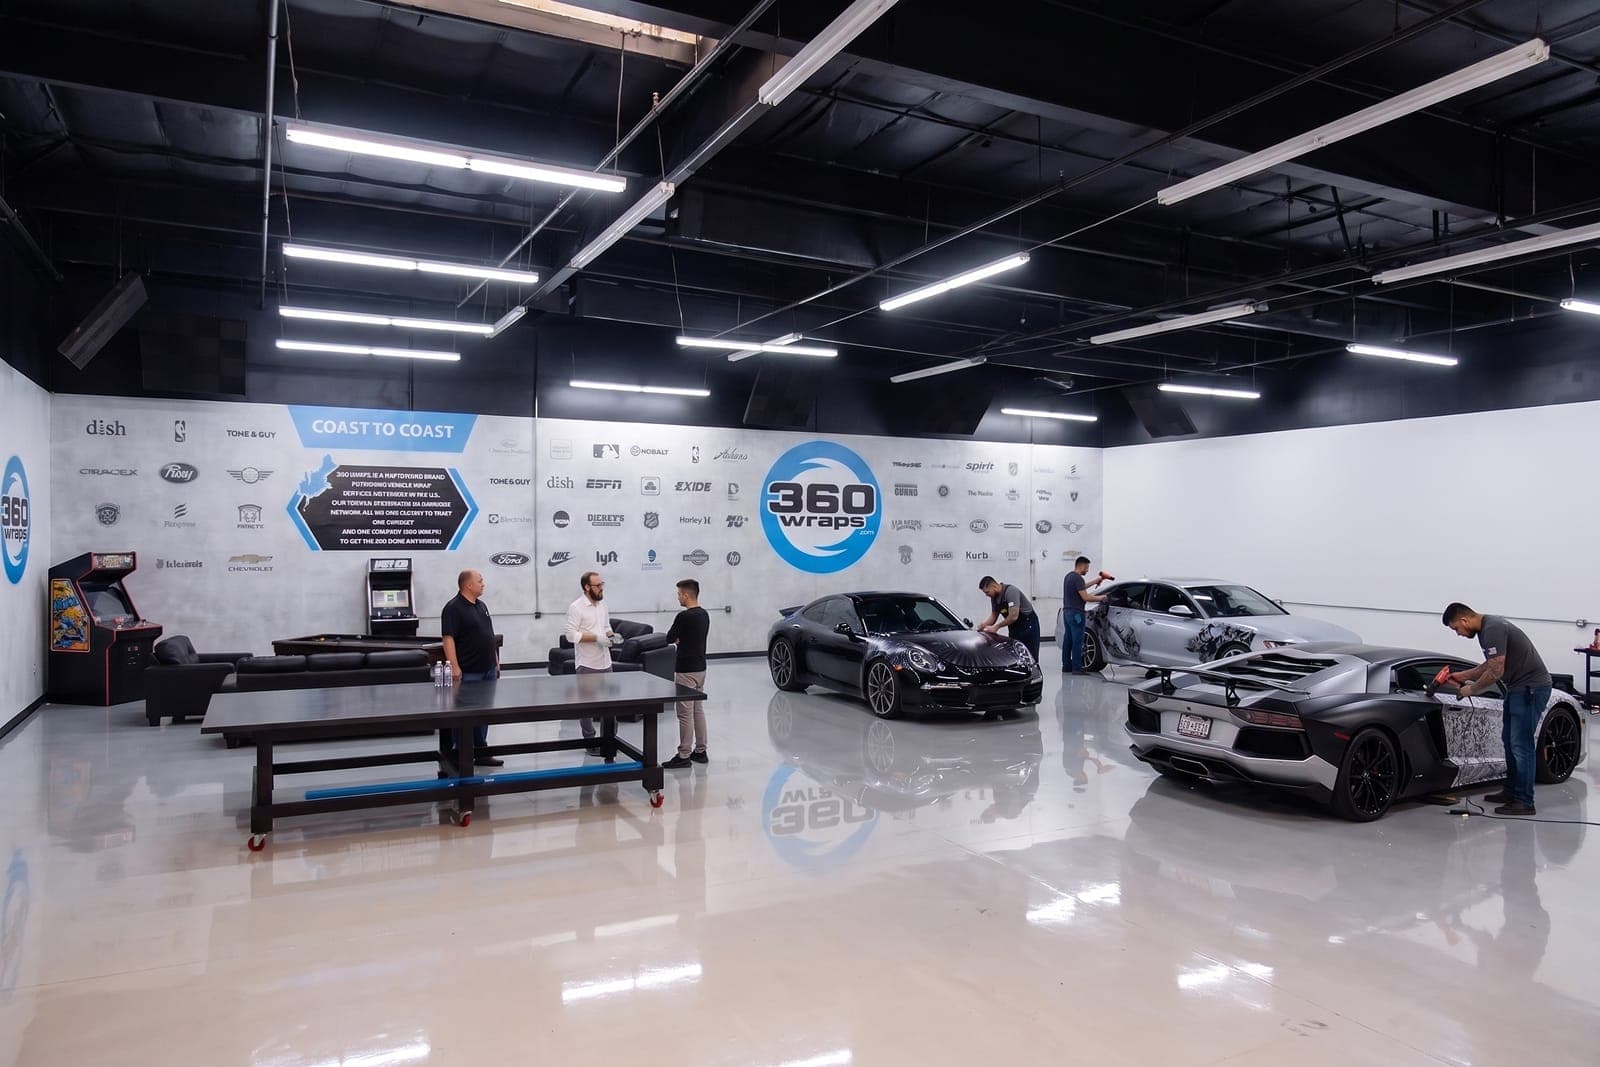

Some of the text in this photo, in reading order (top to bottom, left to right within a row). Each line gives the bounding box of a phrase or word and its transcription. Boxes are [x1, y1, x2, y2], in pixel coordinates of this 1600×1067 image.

[86, 420, 126, 436] dish
[312, 419, 454, 438] COAST TO COAST
[546, 476, 574, 489] dish
[586, 479, 622, 489] ESPN
[674, 481, 712, 492] EXIDE
[769, 482, 875, 515] 360
[2, 495, 29, 527] 360
[780, 515, 865, 531] wraps
[4, 528, 27, 542] wraps
[498, 553, 523, 566] Ford
[552, 551, 571, 561] NIKE
[596, 551, 619, 567] lyft
